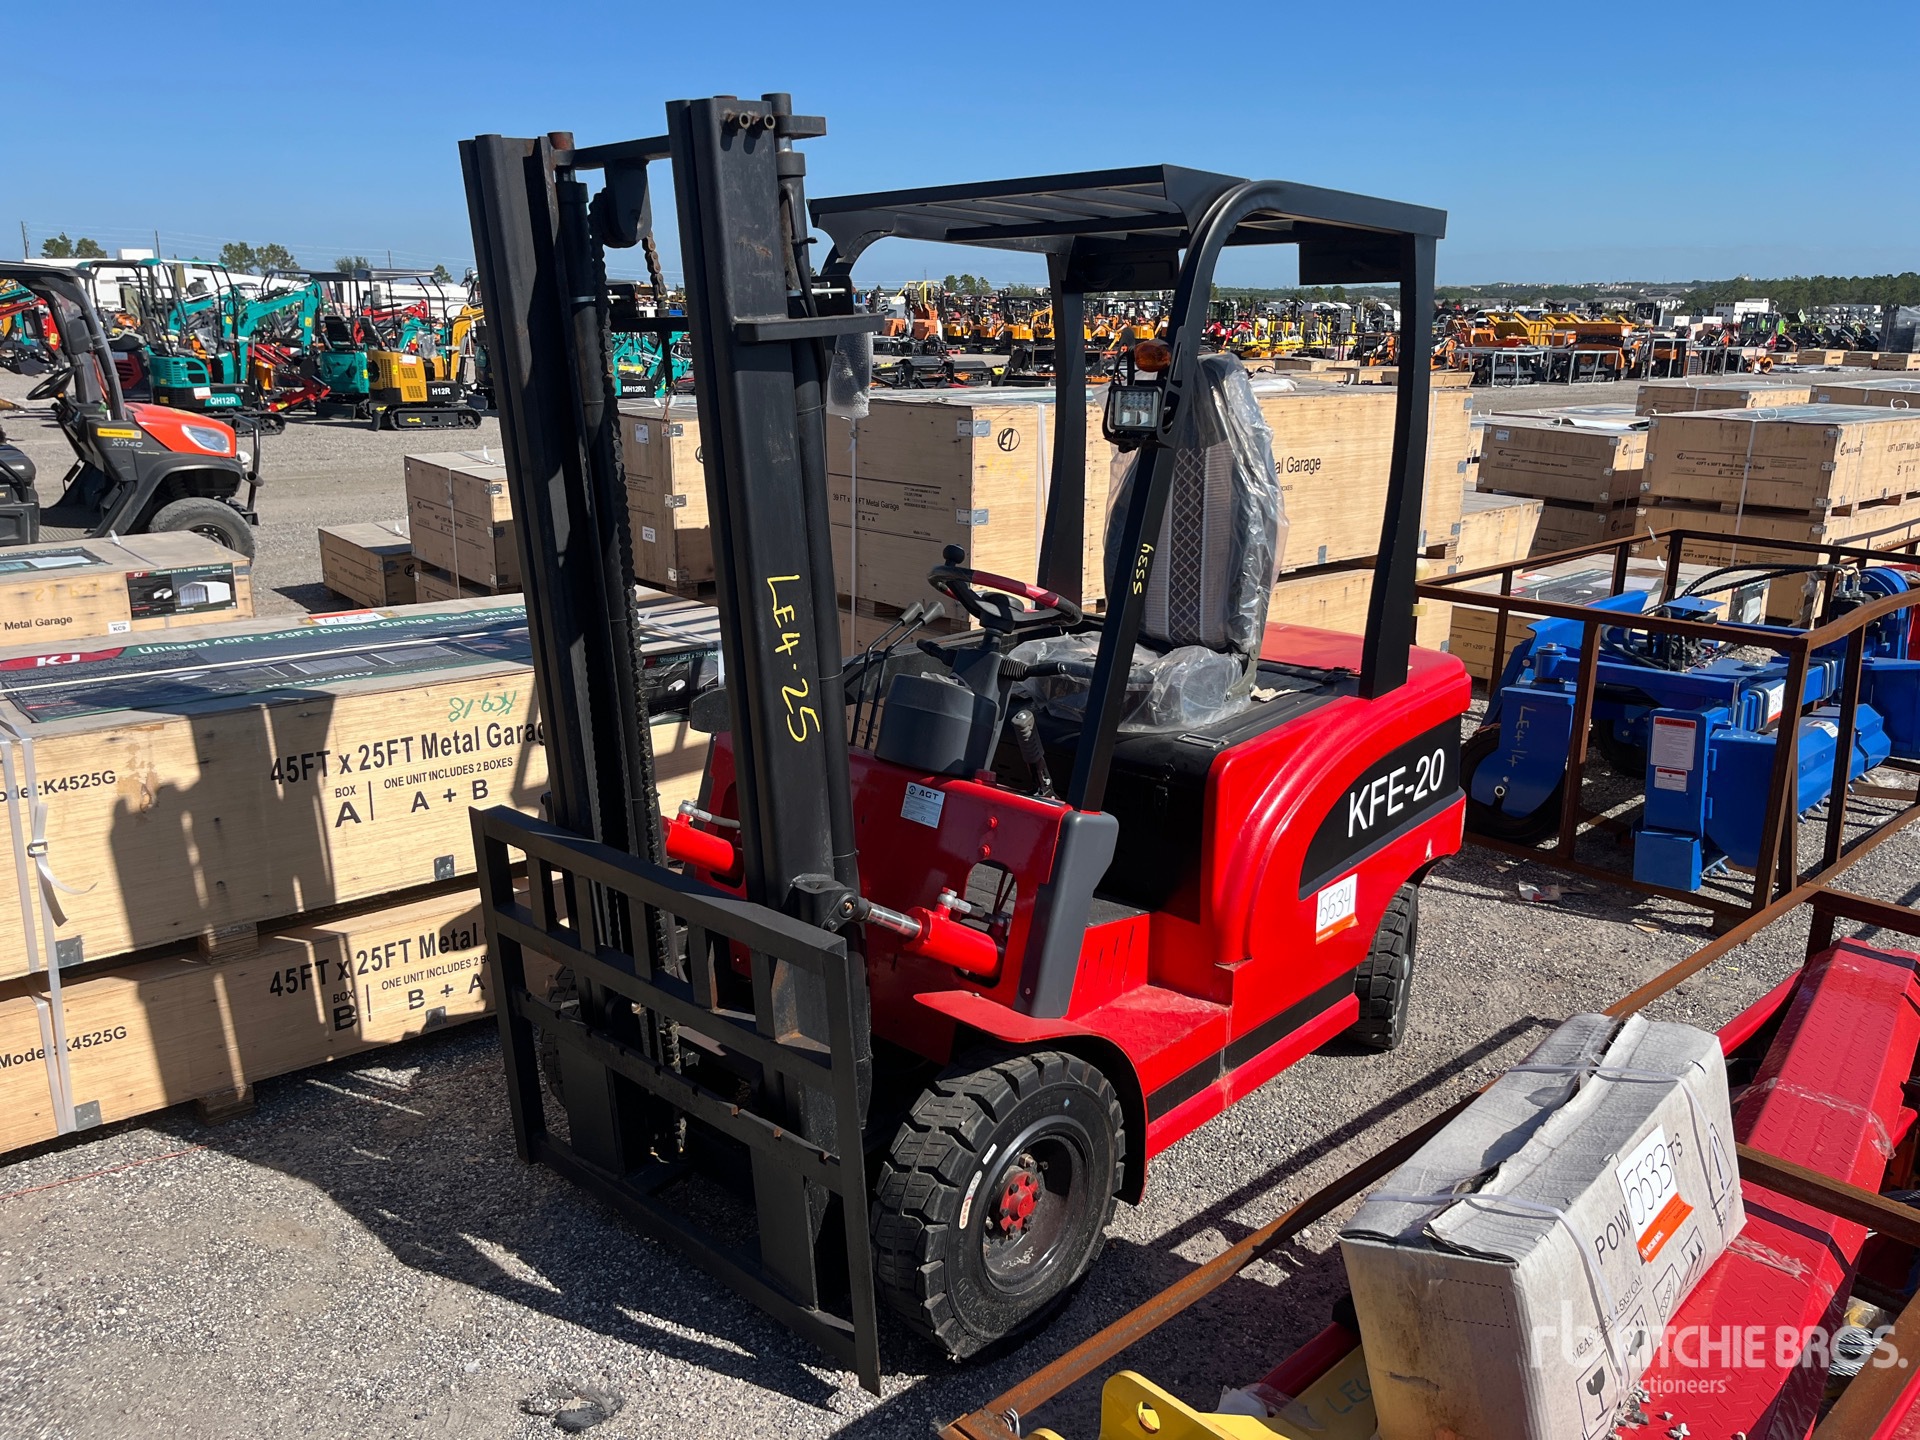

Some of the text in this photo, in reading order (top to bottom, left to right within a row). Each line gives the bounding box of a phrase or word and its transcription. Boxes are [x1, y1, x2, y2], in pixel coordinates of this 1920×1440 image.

[209, 396, 236, 405] QH12R
[431, 387, 451, 396] H12R
[1286, 456, 1321, 475] Garage
[832, 493, 840, 502] 39
[866, 498, 880, 508] Metal
[880, 500, 900, 512] Garage
[1132, 543, 1155, 595] 5534
[4, 615, 73, 631] Metal Garage
[138, 641, 208, 654] Unused
[213, 635, 255, 646] 45FT
[275, 629, 315, 640] 25FT
[318, 624, 376, 636] Double
[379, 616, 434, 628] Garage
[436, 613, 473, 621] Steel
[475, 609, 511, 618] Barn
[37, 653, 81, 667] KJ
[766, 574, 822, 743] LE4-25
[270, 750, 330, 785] 45FT
[338, 753, 353, 775] x
[358, 736, 414, 771] 25FT
[421, 726, 480, 761] Metal
[384, 757, 513, 789] ONE UNIT INCLUDES 2 BOXES
[334, 785, 357, 798] BOX
[411, 779, 489, 813] A + B
[919, 789, 939, 800] AGT
[1348, 748, 1445, 838] KFE-20
[334, 801, 362, 828] A
[1319, 884, 1353, 927] 5534
[269, 922, 477, 997] 45FT x 25FT Metal
[381, 979, 402, 991] ONE
[403, 970, 425, 985] UNIT
[426, 959, 472, 977] INCLUDES
[473, 956, 479, 967] 2
[333, 988, 354, 1004] BOX
[408, 988, 425, 1010] B
[468, 973, 486, 994] A
[333, 1004, 358, 1031] B
[1624, 1143, 1673, 1226] 5533
